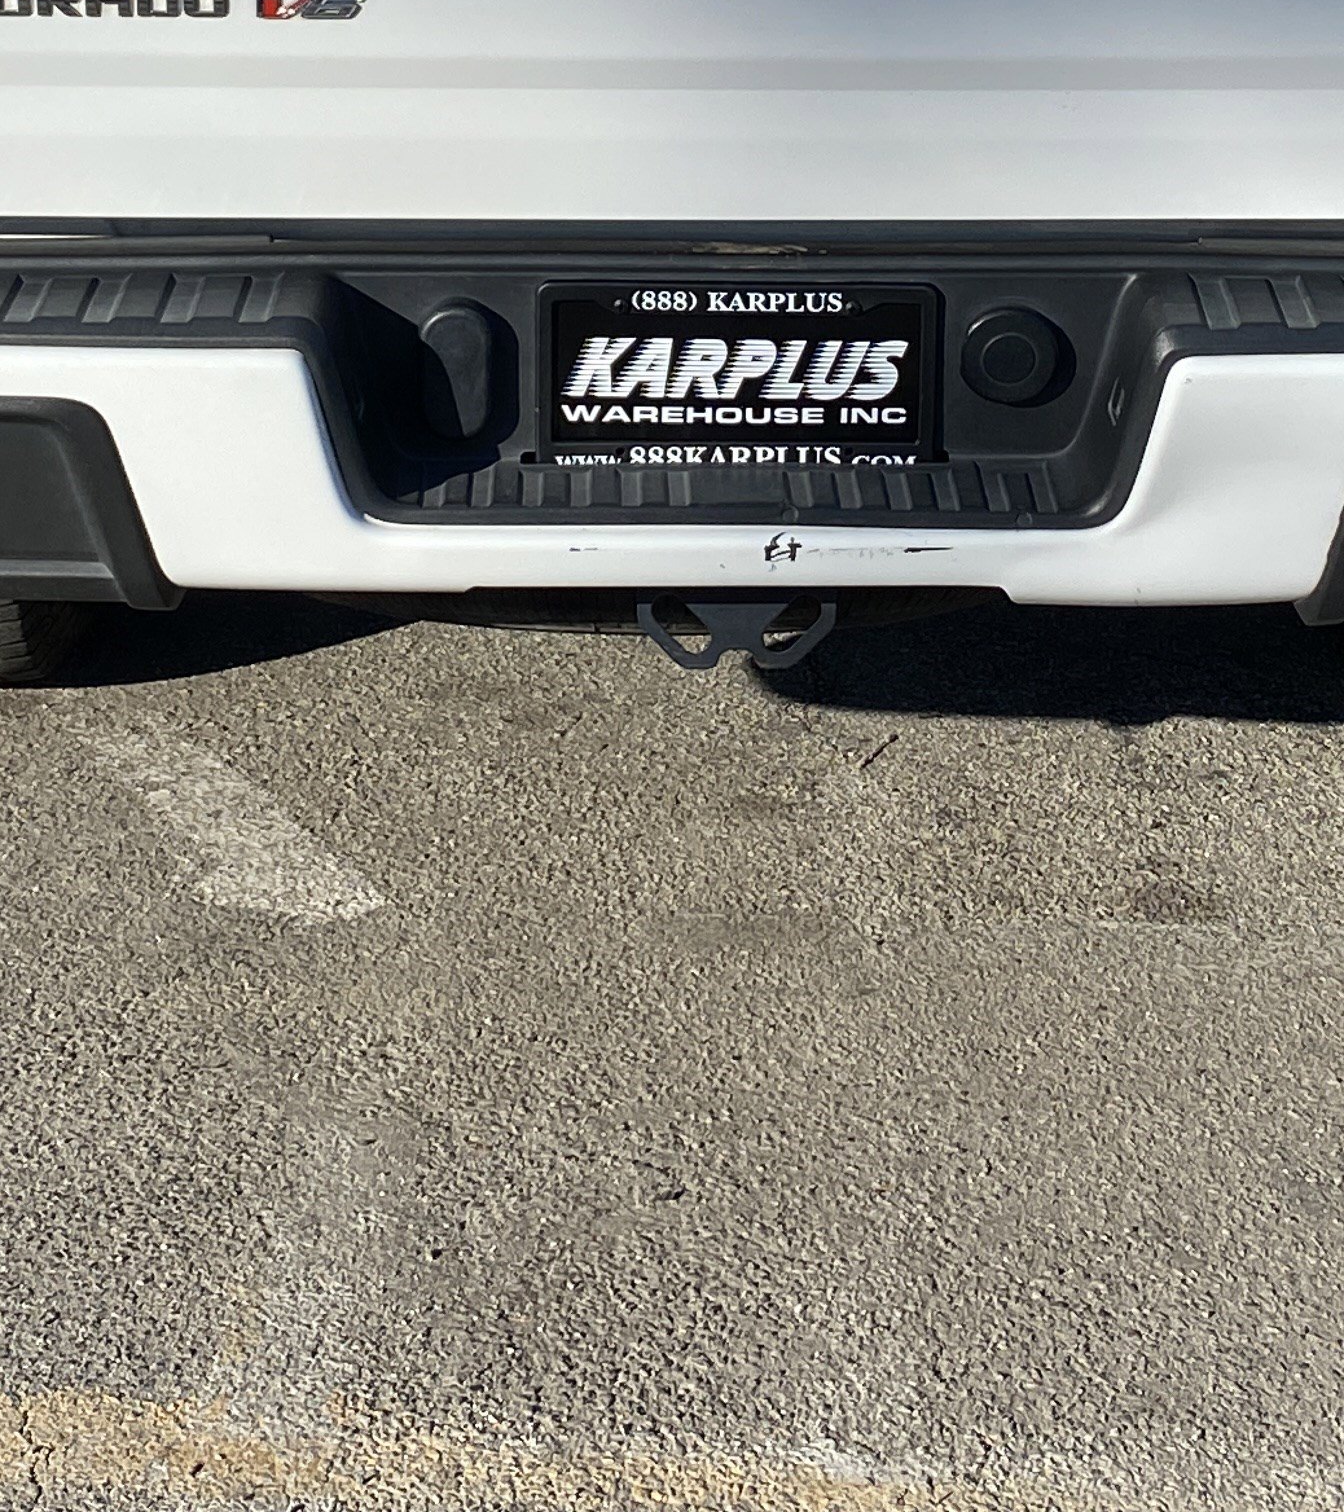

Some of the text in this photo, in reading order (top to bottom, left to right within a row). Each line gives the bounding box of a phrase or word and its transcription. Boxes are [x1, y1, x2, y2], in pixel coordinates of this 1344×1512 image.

[631, 291, 843, 313] (888) KARPLUS
[560, 337, 909, 401] KARPLUS
[561, 405, 907, 424] WAREHOUSE INC
